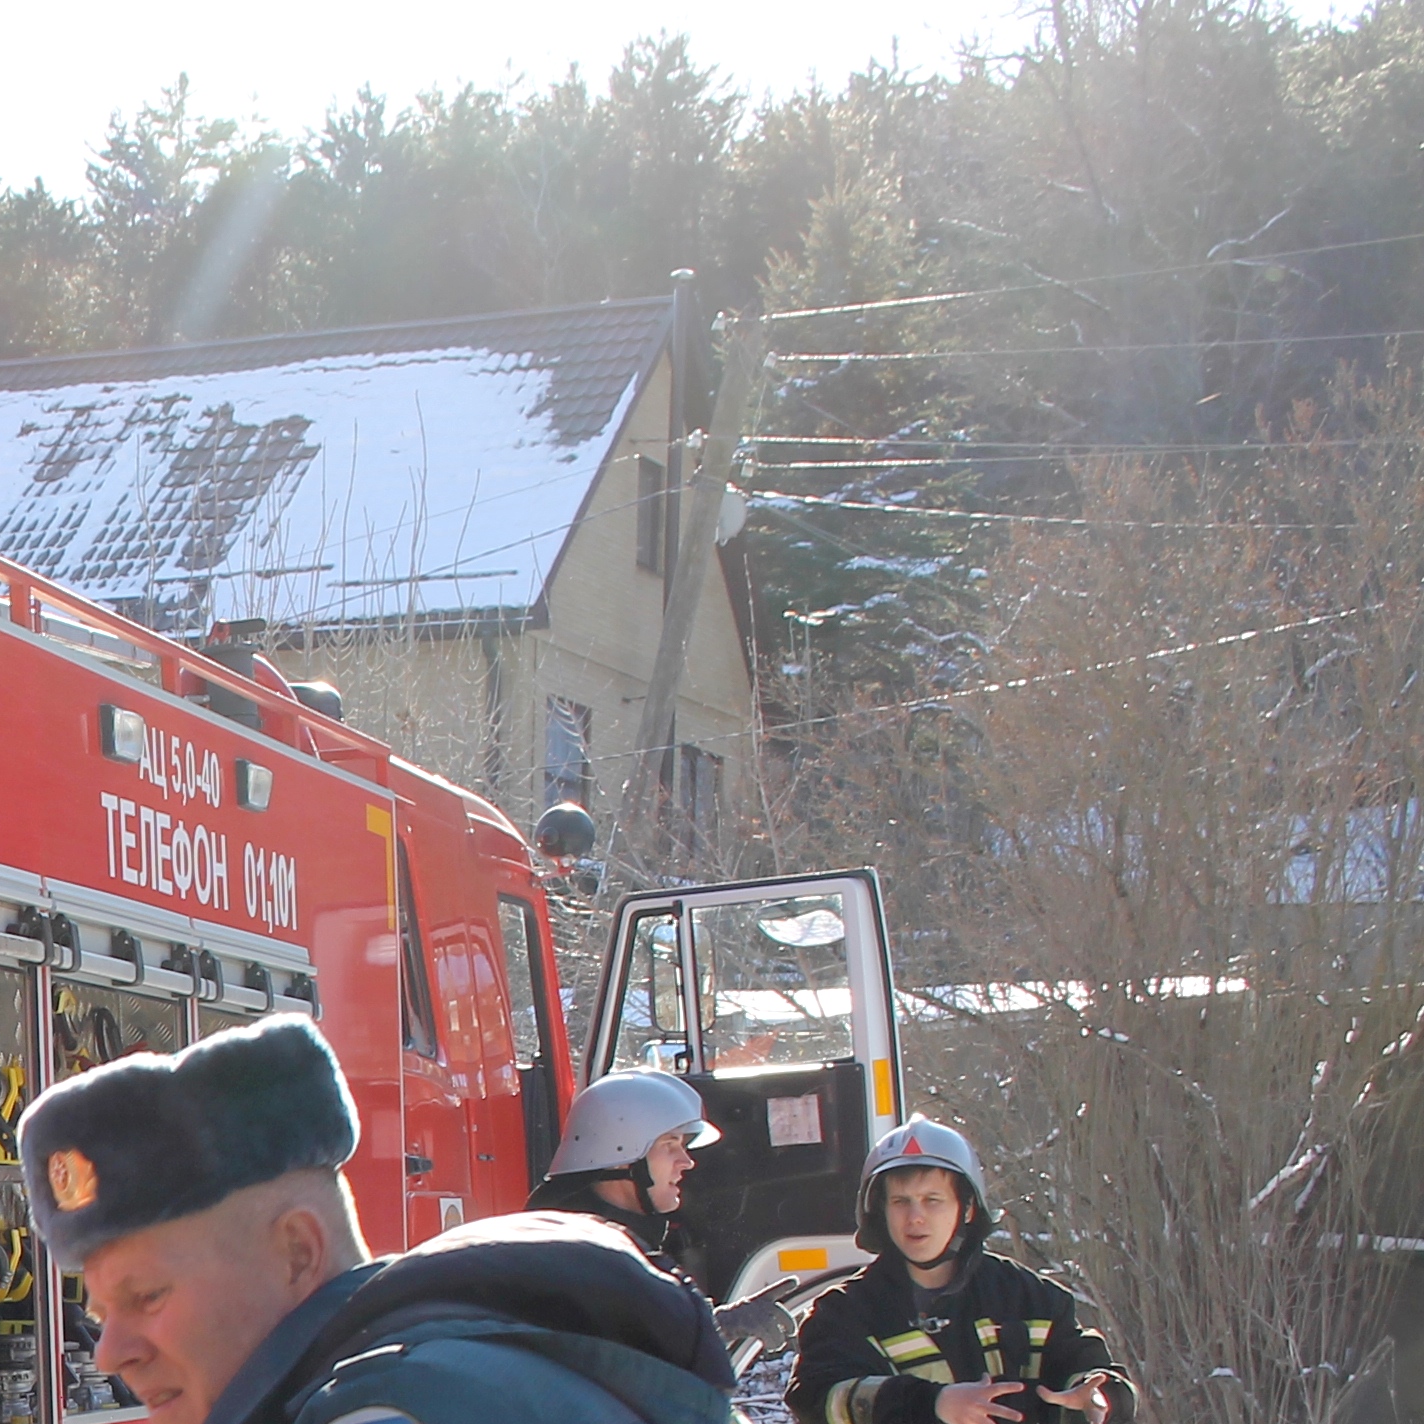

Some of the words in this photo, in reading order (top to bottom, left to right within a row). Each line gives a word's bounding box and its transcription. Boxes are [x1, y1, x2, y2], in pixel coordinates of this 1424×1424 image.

[139, 723, 168, 800] АЦ
[170, 735, 221, 809] 5,0-40
[101, 791, 230, 911] ТЕЛЕФОН
[244, 841, 298, 934] 01,101
